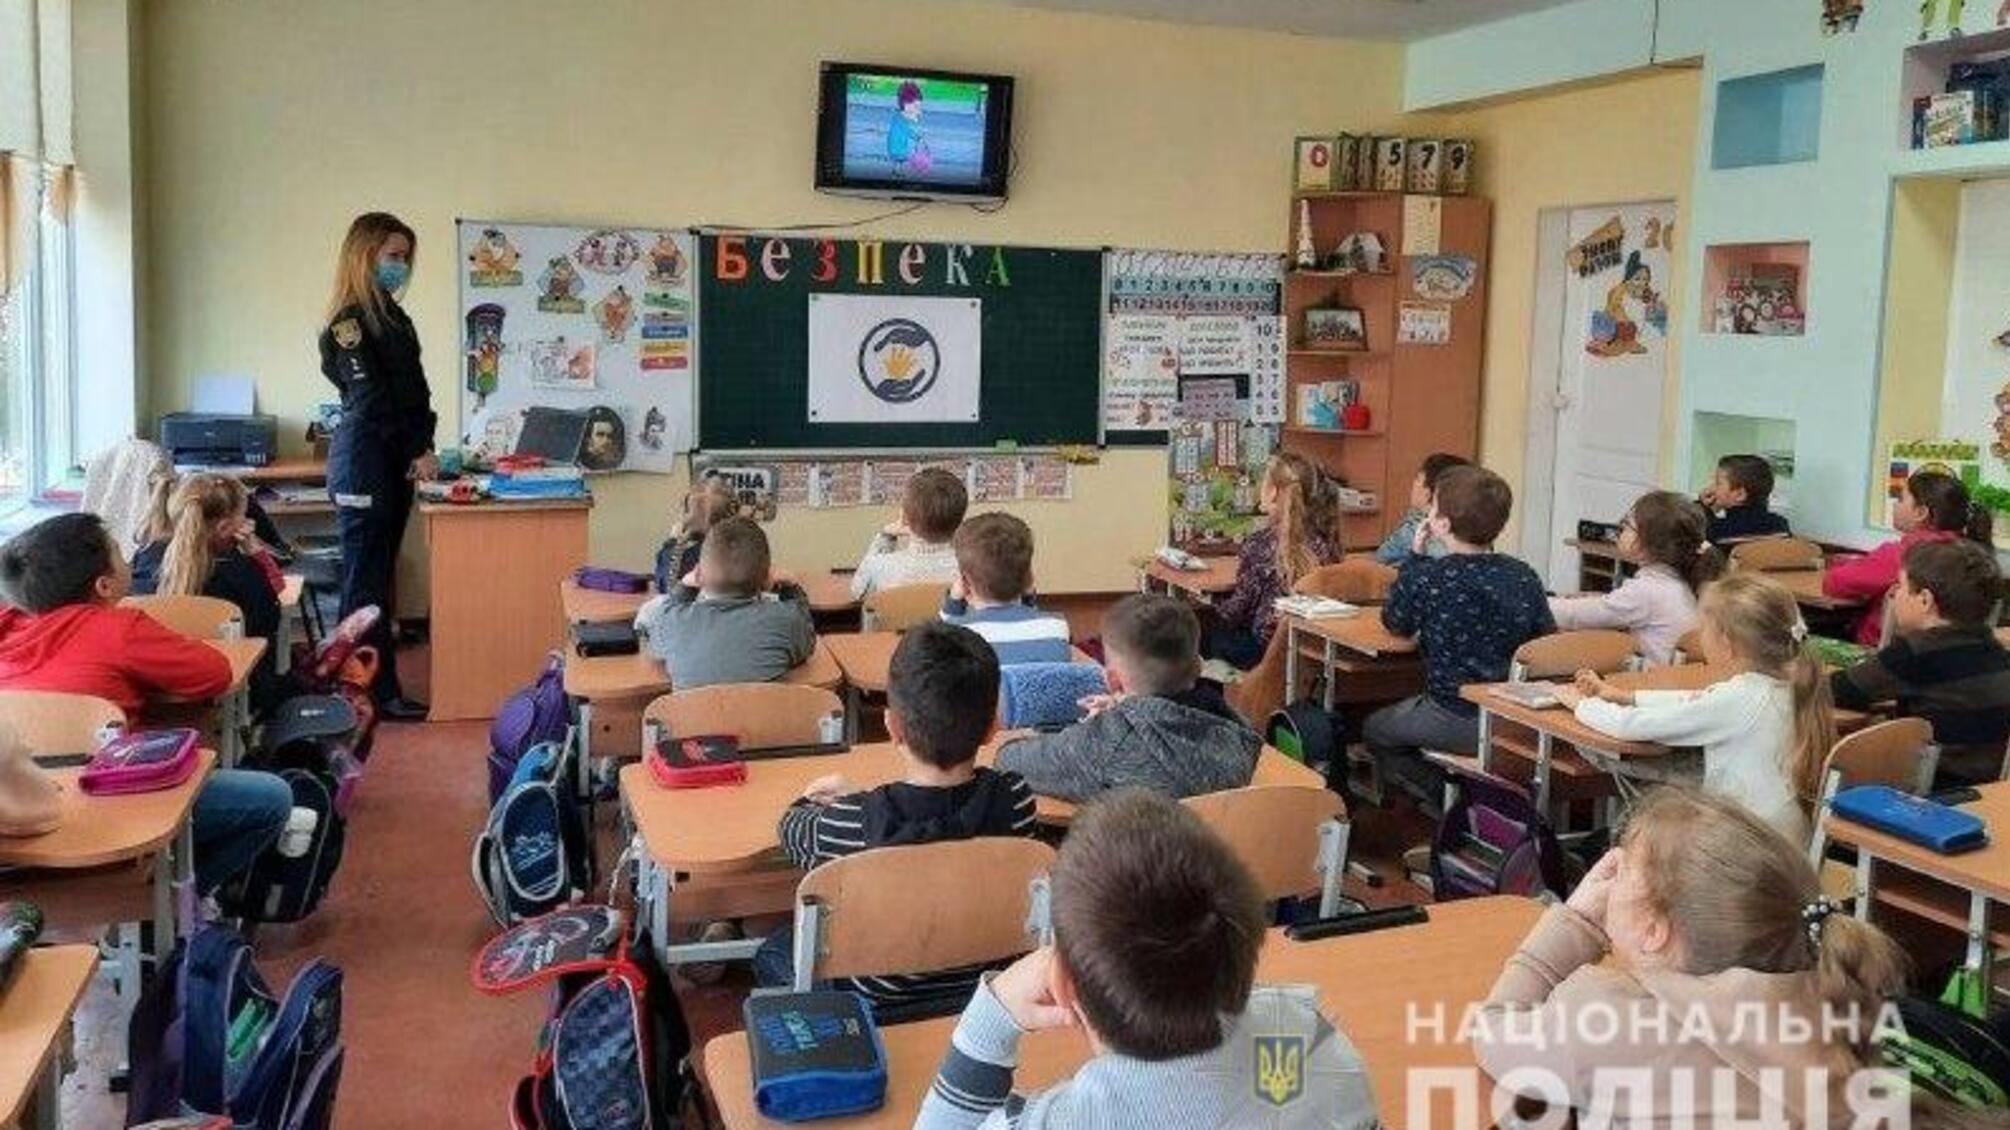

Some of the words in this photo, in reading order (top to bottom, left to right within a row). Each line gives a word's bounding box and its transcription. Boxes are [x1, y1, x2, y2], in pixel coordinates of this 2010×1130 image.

[1388, 141, 1401, 166] 5
[1421, 144, 1436, 169] 7
[1451, 146, 1465, 170] 9
[1258, 323, 1272, 337] 10
